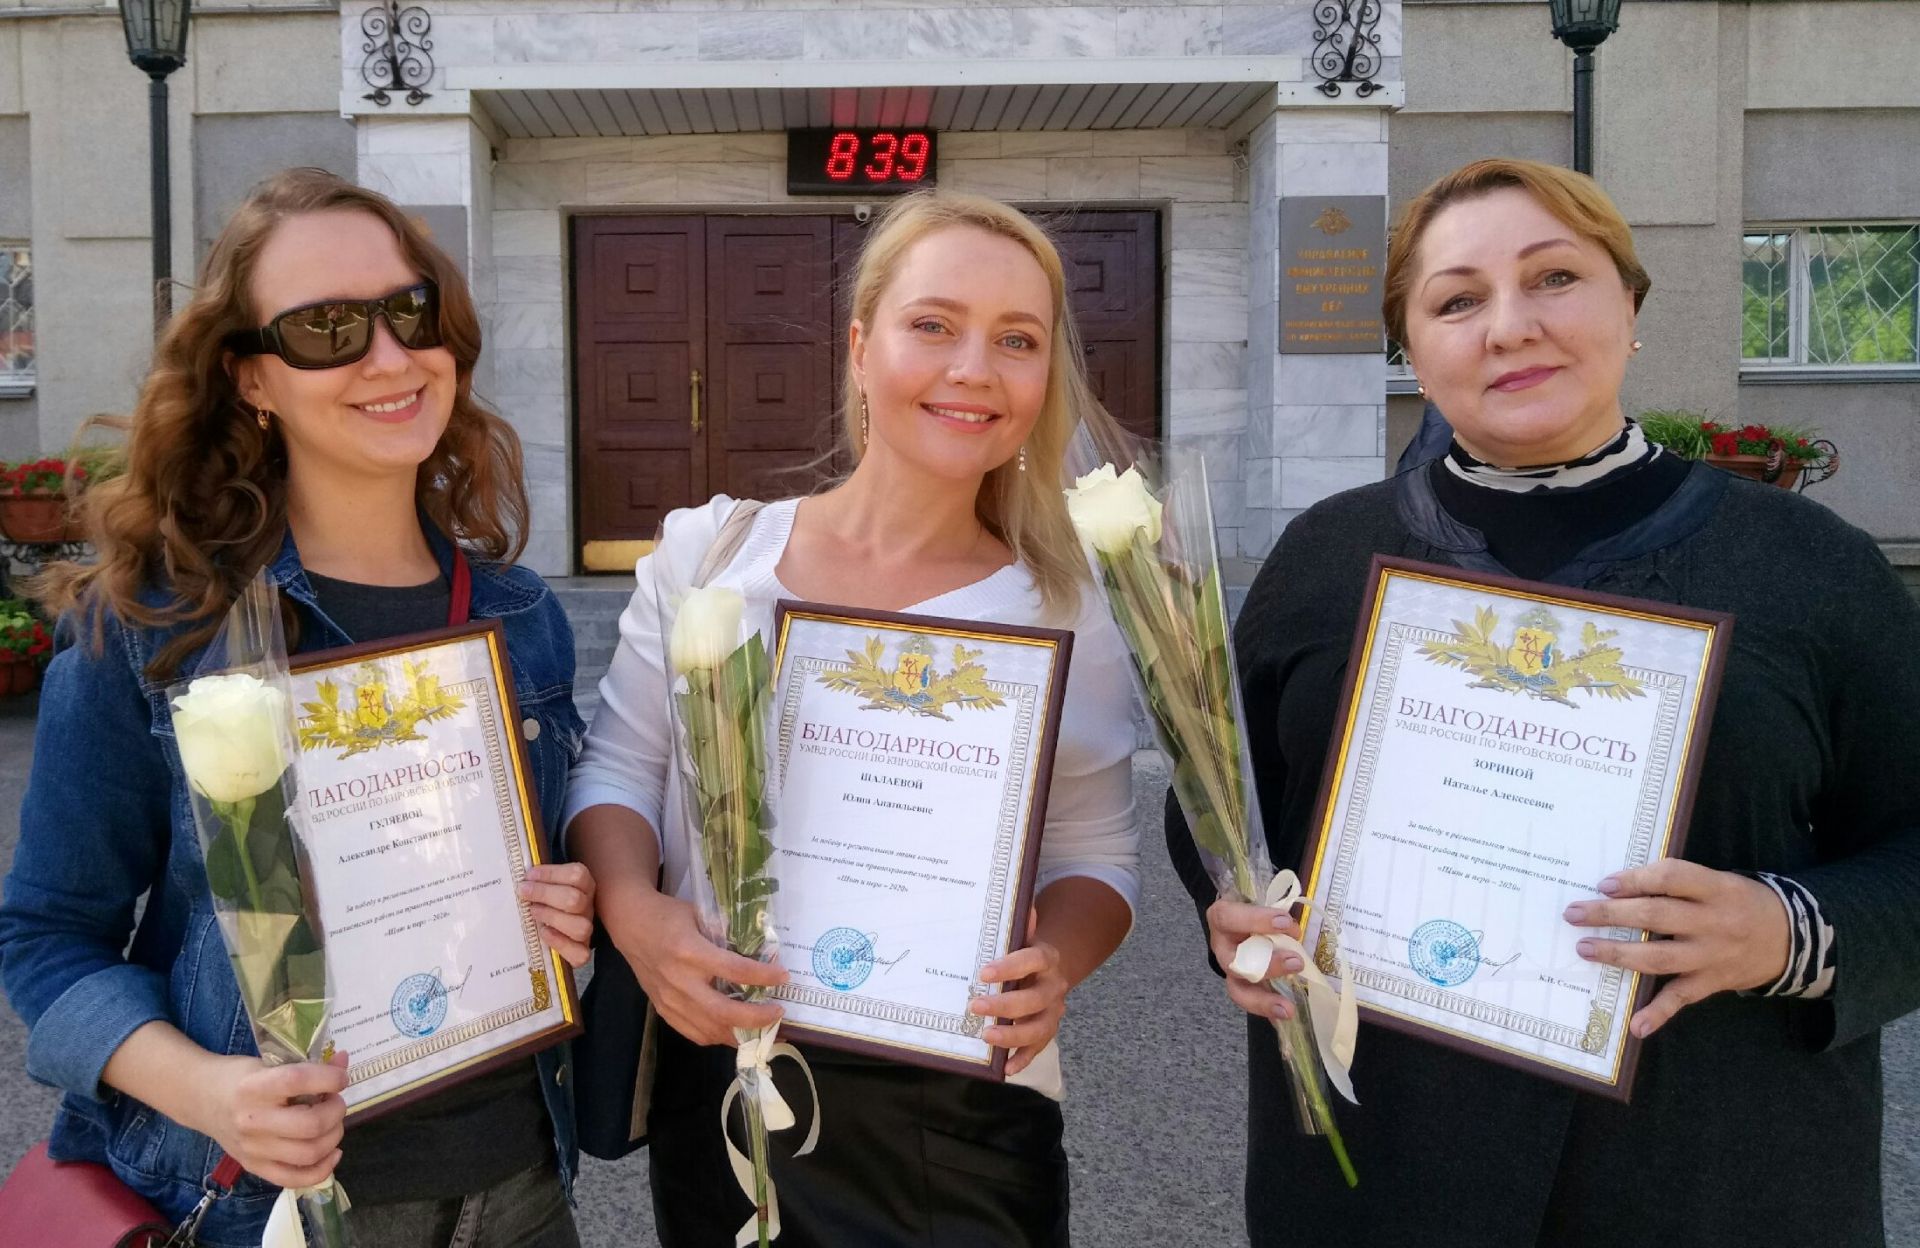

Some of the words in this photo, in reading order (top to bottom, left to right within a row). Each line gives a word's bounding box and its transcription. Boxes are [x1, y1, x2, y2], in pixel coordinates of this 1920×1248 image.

[801, 722, 1000, 767] БЛАГОДАРНОСТЬ
[1397, 696, 1637, 763] БЛАГОДАРНОСТЬ
[799, 743, 828, 756] УМВД
[828, 747, 869, 762] РОССИИ
[870, 753, 886, 764] ПО
[886, 755, 948, 773] КИРОВСКОЙ
[949, 764, 998, 781] ОБЛАСТИ
[1394, 718, 1428, 735] УМВД
[1428, 726, 1477, 746] РОССИИ
[1479, 737, 1497, 749] ПО
[1498, 740, 1573, 766] КИРОВСКОЙ
[1575, 758, 1634, 779] ОБЛАСТИ
[308, 750, 482, 808] ЛАГОДАРНОСТЬ
[860, 772, 924, 790] ШАЛАЕВОЙ
[1472, 757, 1535, 781] ЗОРИНОЙ
[311, 813, 327, 825] ВД
[327, 802, 367, 820] РОССИИ
[369, 797, 383, 810] ПО
[384, 782, 441, 805] КИРОВСКОЙ
[442, 769, 484, 790] ОБЛАСТИ
[873, 798, 934, 815] Анатольевне
[1442, 776, 1489, 796] Наталье
[1490, 788, 1555, 811] Алексеевне
[369, 809, 424, 831] ГУЛЯЕВОЙ
[338, 843, 391, 865] Александре
